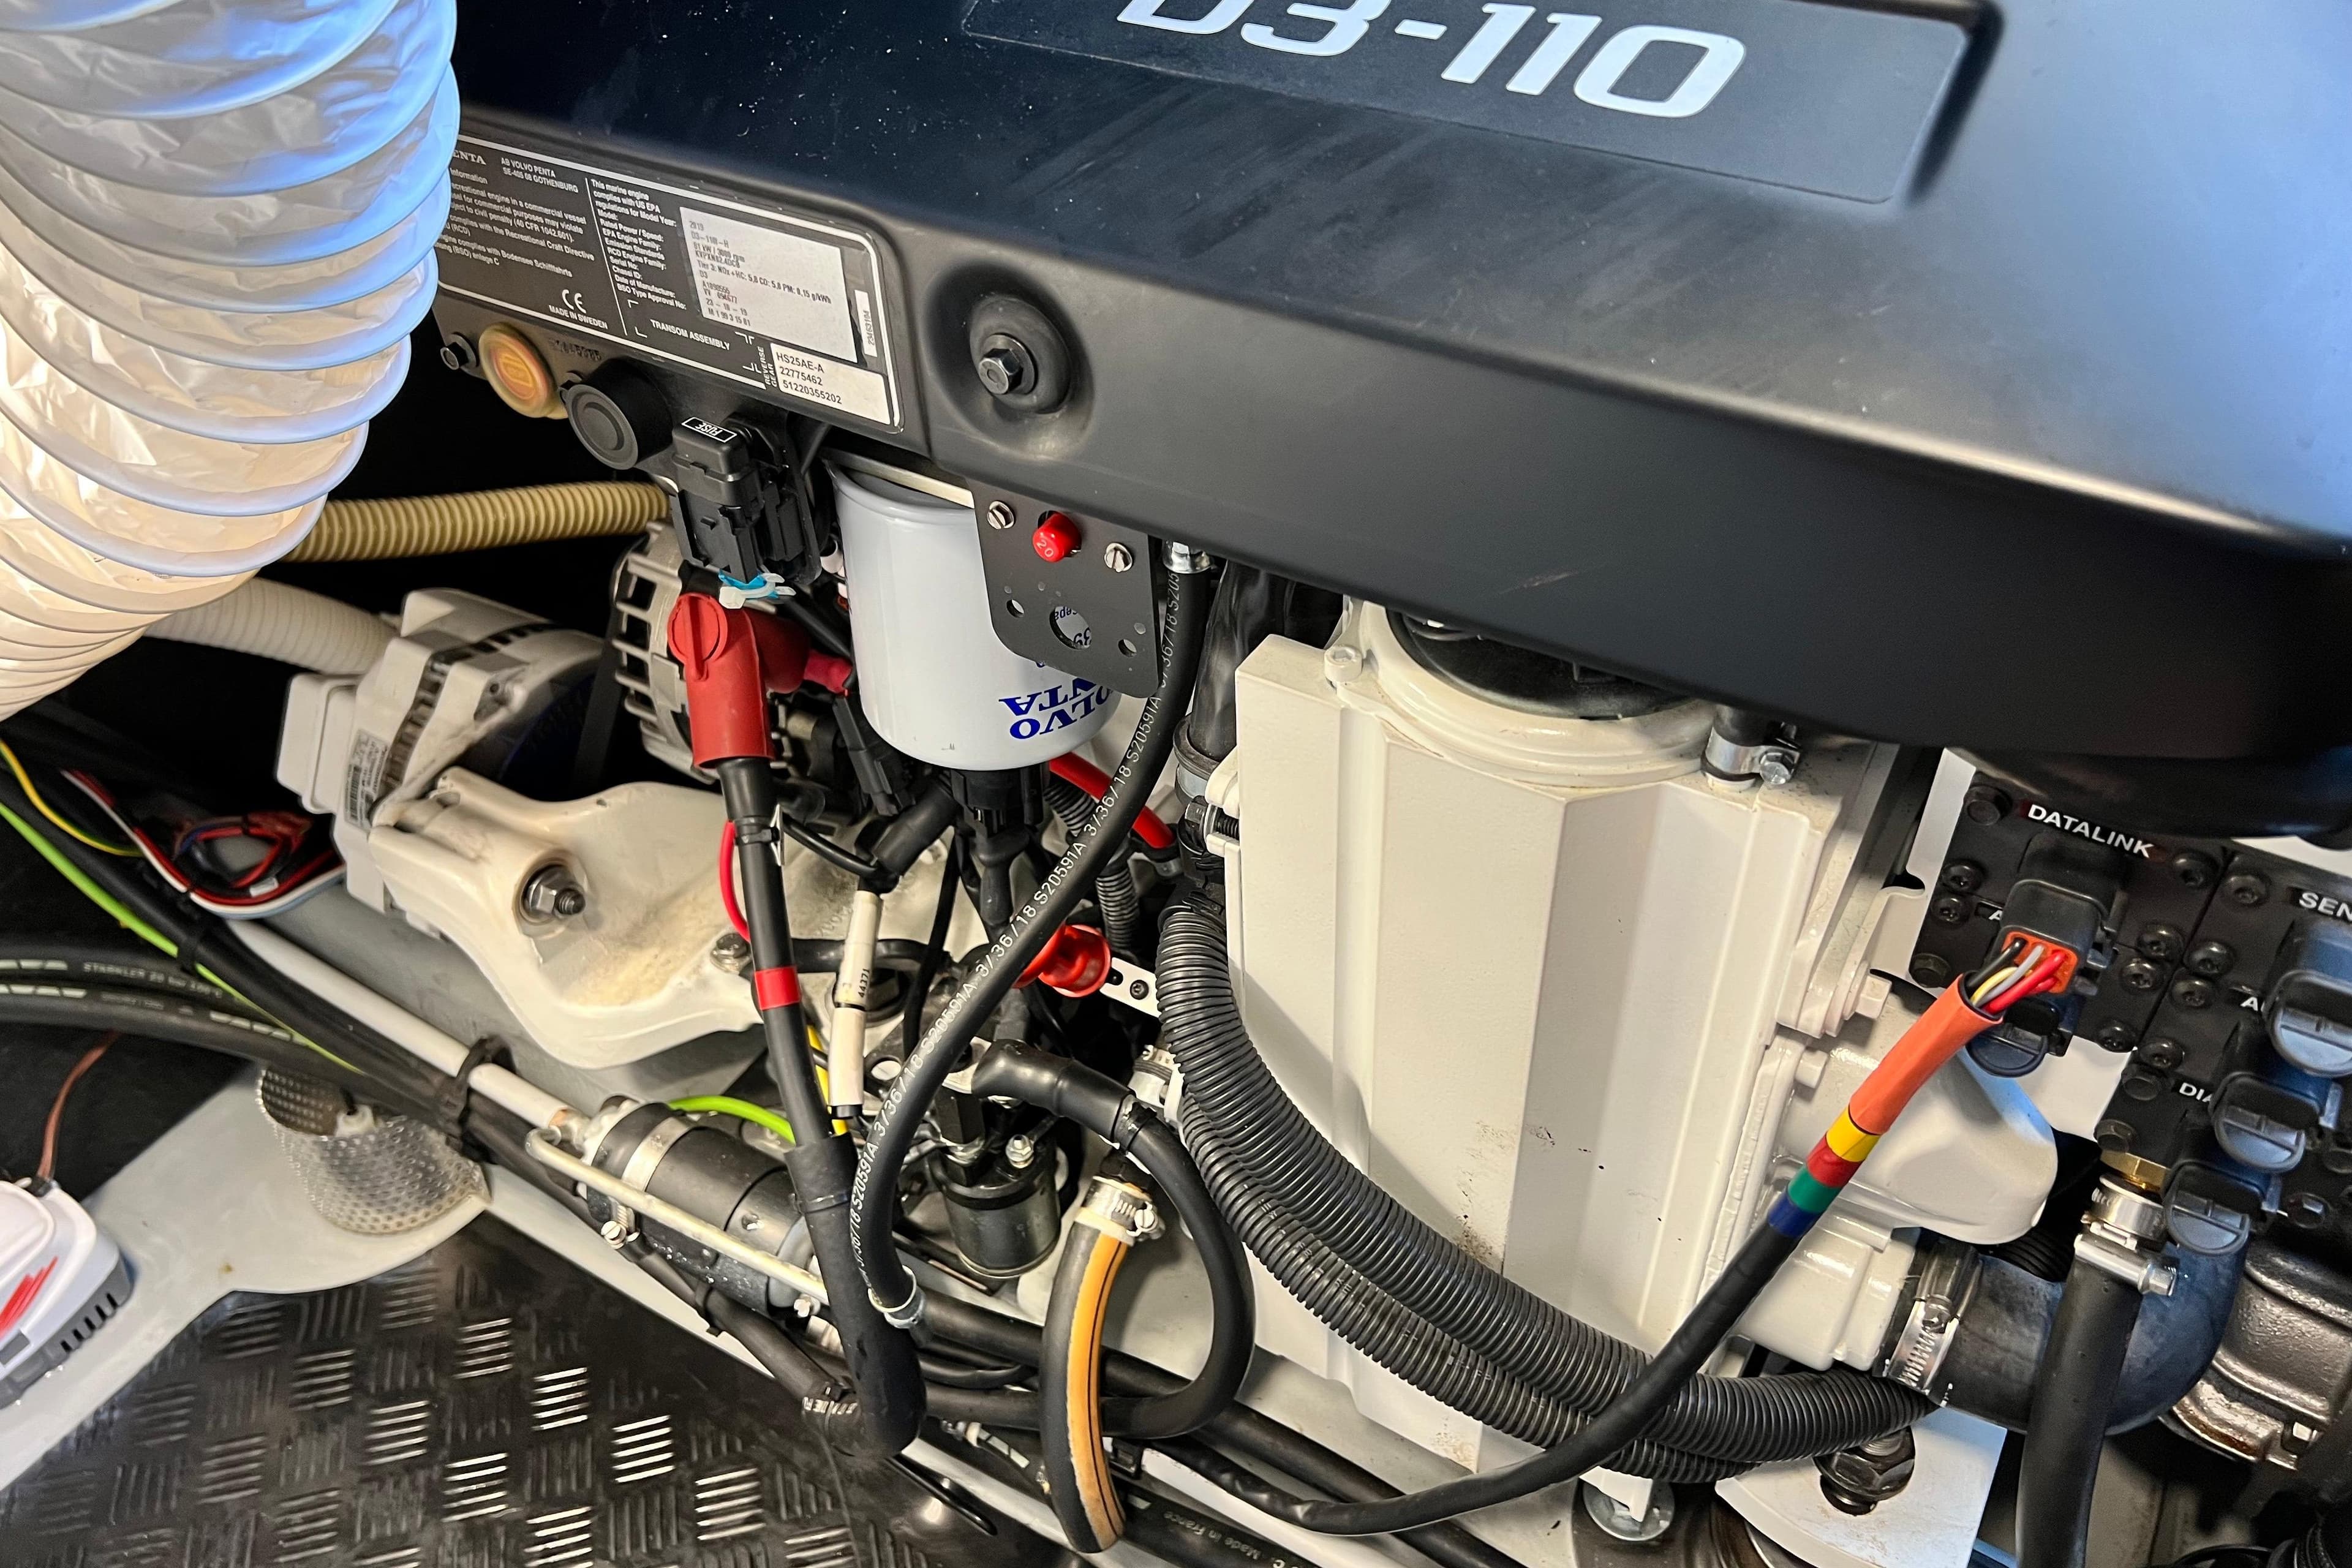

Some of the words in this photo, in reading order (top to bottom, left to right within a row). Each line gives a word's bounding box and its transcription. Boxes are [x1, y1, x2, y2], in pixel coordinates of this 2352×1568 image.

[454, 150, 486, 165] ENTA
[502, 157, 510, 166] AB
[510, 159, 533, 172] VOLVO
[533, 166, 556, 178] PENTA
[533, 175, 579, 193] GOTHENBURG
[590, 179, 606, 190] This
[605, 184, 627, 195] marine
[627, 190, 649, 201] engine
[451, 183, 487, 197] ecreational
[487, 192, 510, 203] engine
[510, 197, 518, 206] in
[524, 202, 564, 219] commercial
[564, 213, 587, 225] vessel
[463, 194, 473, 203] for
[474, 198, 512, 214] commercial
[513, 209, 545, 224] purposes
[545, 218, 559, 229] may
[559, 222, 584, 235] violate
[593, 190, 622, 203] complies
[621, 197, 636, 207] with
[635, 200, 646, 209] US
[646, 202, 661, 214] EPA
[595, 201, 630, 215] regulations
[630, 208, 639, 217] for
[639, 210, 659, 222] Model
[658, 215, 677, 227] Year:
[466, 205, 474, 214] to
[474, 208, 489, 219] civil
[489, 213, 512, 227] penalty
[513, 218, 525, 228] (40
[525, 222, 540, 232] CFR
[597, 209, 619, 221] Model:
[689, 221, 704, 232] 2019
[449, 215, 478, 228] complies
[478, 222, 493, 232] with
[493, 226, 505, 236] the
[505, 228, 546, 247] Recreational
[546, 240, 564, 252] Craft
[564, 245, 595, 262] Directive
[451, 223, 471, 237] (RCD)
[600, 218, 618, 230] Rated
[618, 223, 638, 235] Power
[641, 229, 664, 242] Speed:
[602, 227, 616, 238] EPA
[616, 232, 638, 244] Engine
[638, 238, 662, 252] Family:
[441, 235, 458, 244] ngine
[458, 239, 487, 252] complies
[486, 247, 501, 257] with
[501, 250, 534, 266] Bodensee
[453, 245, 472, 259] (BSO)
[605, 237, 633, 252] Emission
[633, 245, 665, 260] Standards
[607, 246, 622, 257] RCD
[622, 251, 644, 263] Engine
[644, 257, 667, 271] Family:
[609, 255, 628, 267] Serial
[627, 261, 639, 271] No:
[614, 274, 629, 285] Date
[636, 281, 676, 299] Manufacture:
[633, 271, 643, 281] ID:
[617, 283, 631, 293] BSO
[631, 287, 648, 299] Type
[647, 292, 675, 307] Approval
[674, 300, 687, 310] No:
[548, 305, 570, 318] MADE
[569, 311, 578, 320] IN
[577, 314, 608, 330] SWEDEN
[650, 318, 688, 338] TRANSOM
[689, 331, 730, 350] ASSEMBLY
[757, 346, 772, 386] REVERSE
[767, 363, 778, 387] GEAR
[776, 352, 824, 374] HS25AE-A
[779, 366, 823, 386] 22775462
[783, 380, 843, 404] 51220355202
[695, 421, 723, 437] FUSE
[1036, 540, 1054, 557] 20
[1167, 571, 1180, 611] S205
[1009, 685, 1110, 739] OLVO
[1084, 765, 1132, 837] 3/36/18
[1126, 696, 1162, 763] S20591A
[2027, 804, 2154, 858] DATALINK
[976, 905, 1036, 978] 3/36/18
[1033, 842, 1087, 905] S20591A
[2299, 892, 2352, 921] SEN
[921, 982, 977, 1054] S20591A
[853, 1142, 878, 1210] S20591A
[1164, 1510, 1206, 1536] France
[1208, 1530, 1223, 1543] in
[1225, 1536, 1262, 1560] Made
